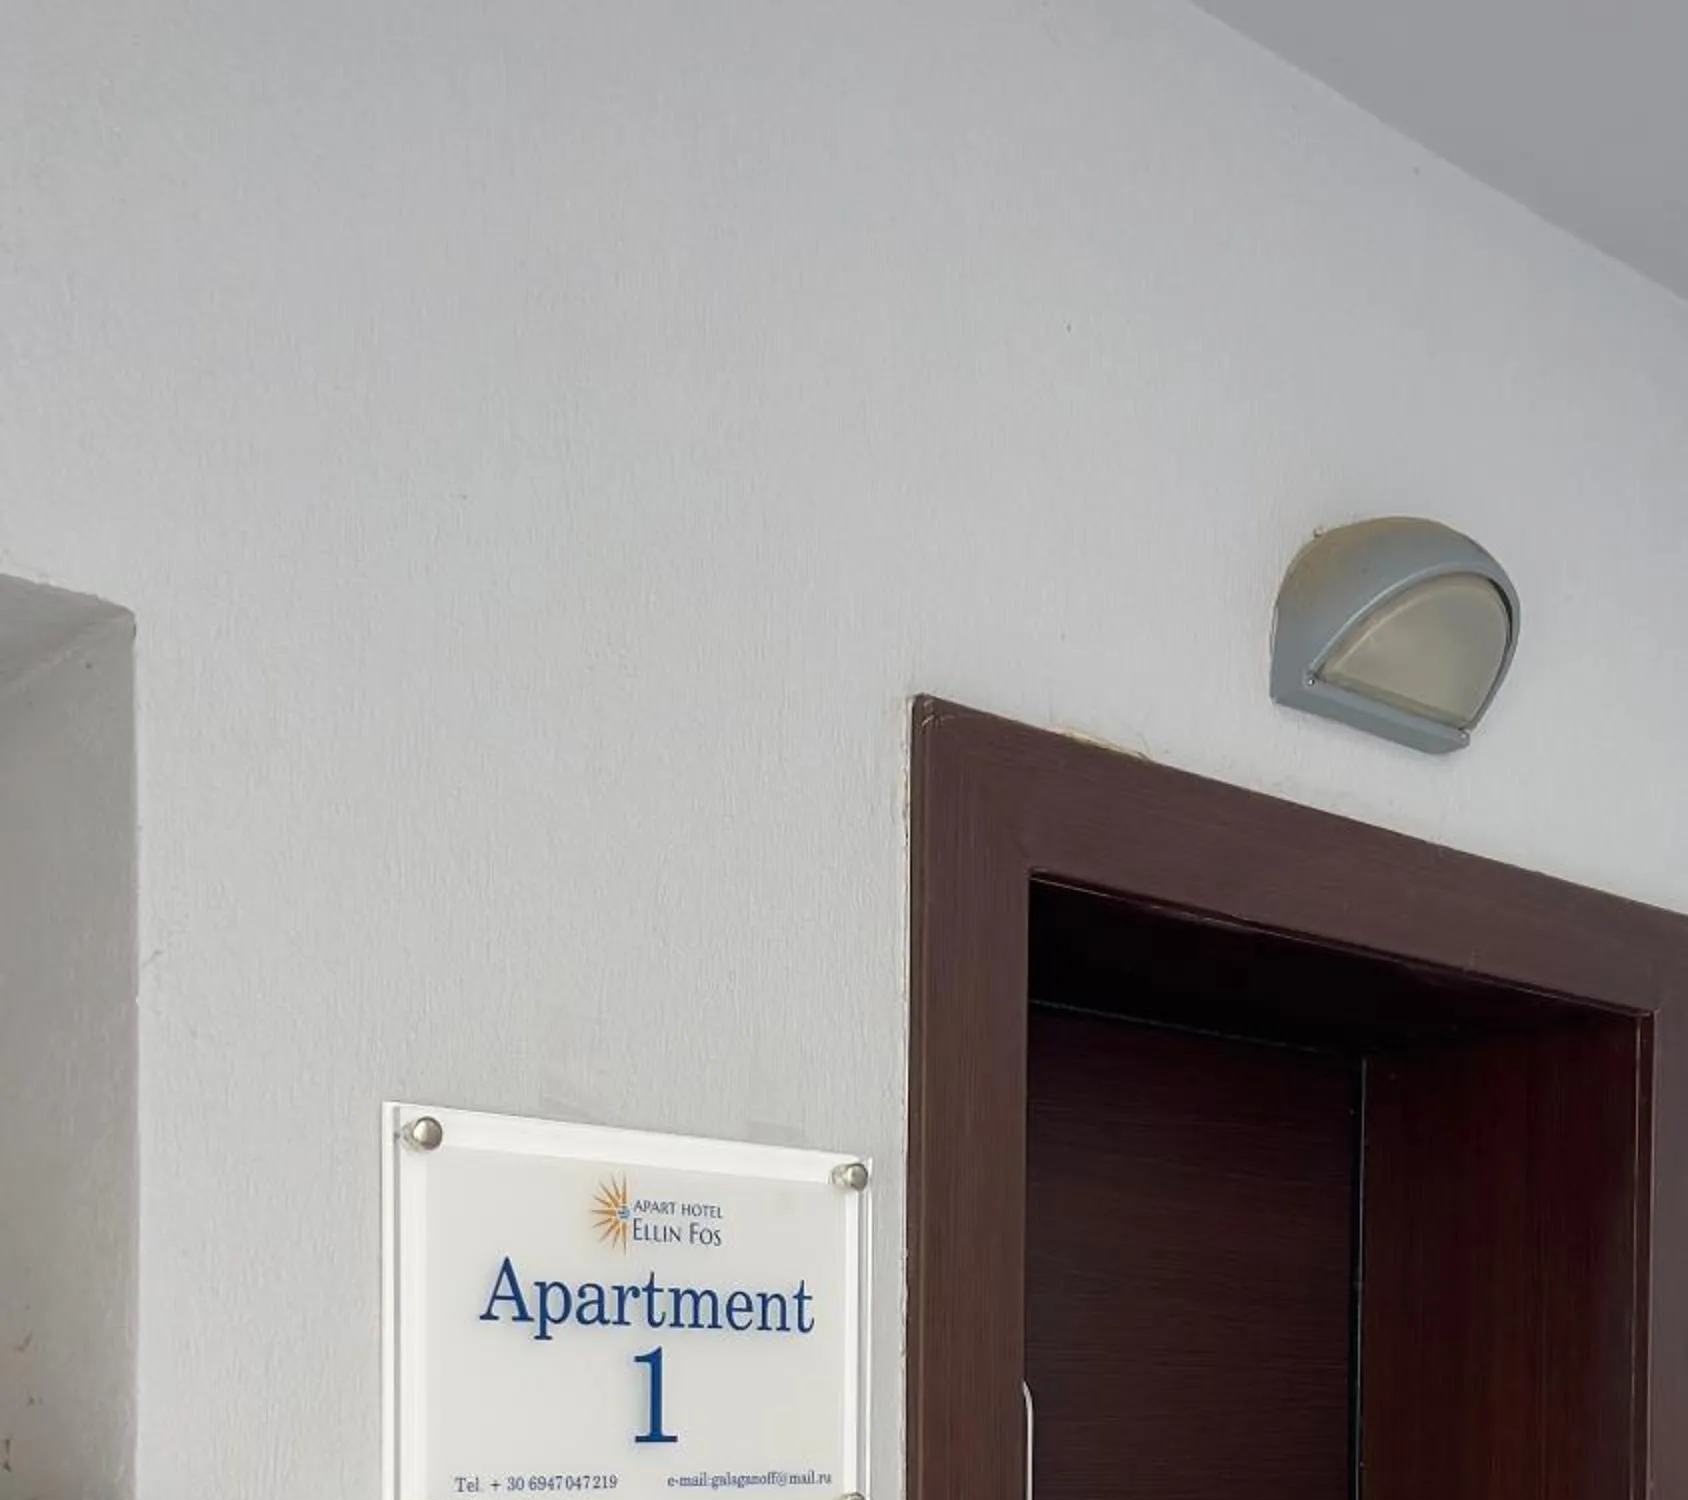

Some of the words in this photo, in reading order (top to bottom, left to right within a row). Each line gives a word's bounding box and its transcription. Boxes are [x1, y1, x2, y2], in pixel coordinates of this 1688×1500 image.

[633, 1199, 676, 1216] APART
[682, 1203, 724, 1219] HOTEL
[480, 1256, 815, 1340] Apartment
[634, 1346, 678, 1443] 1
